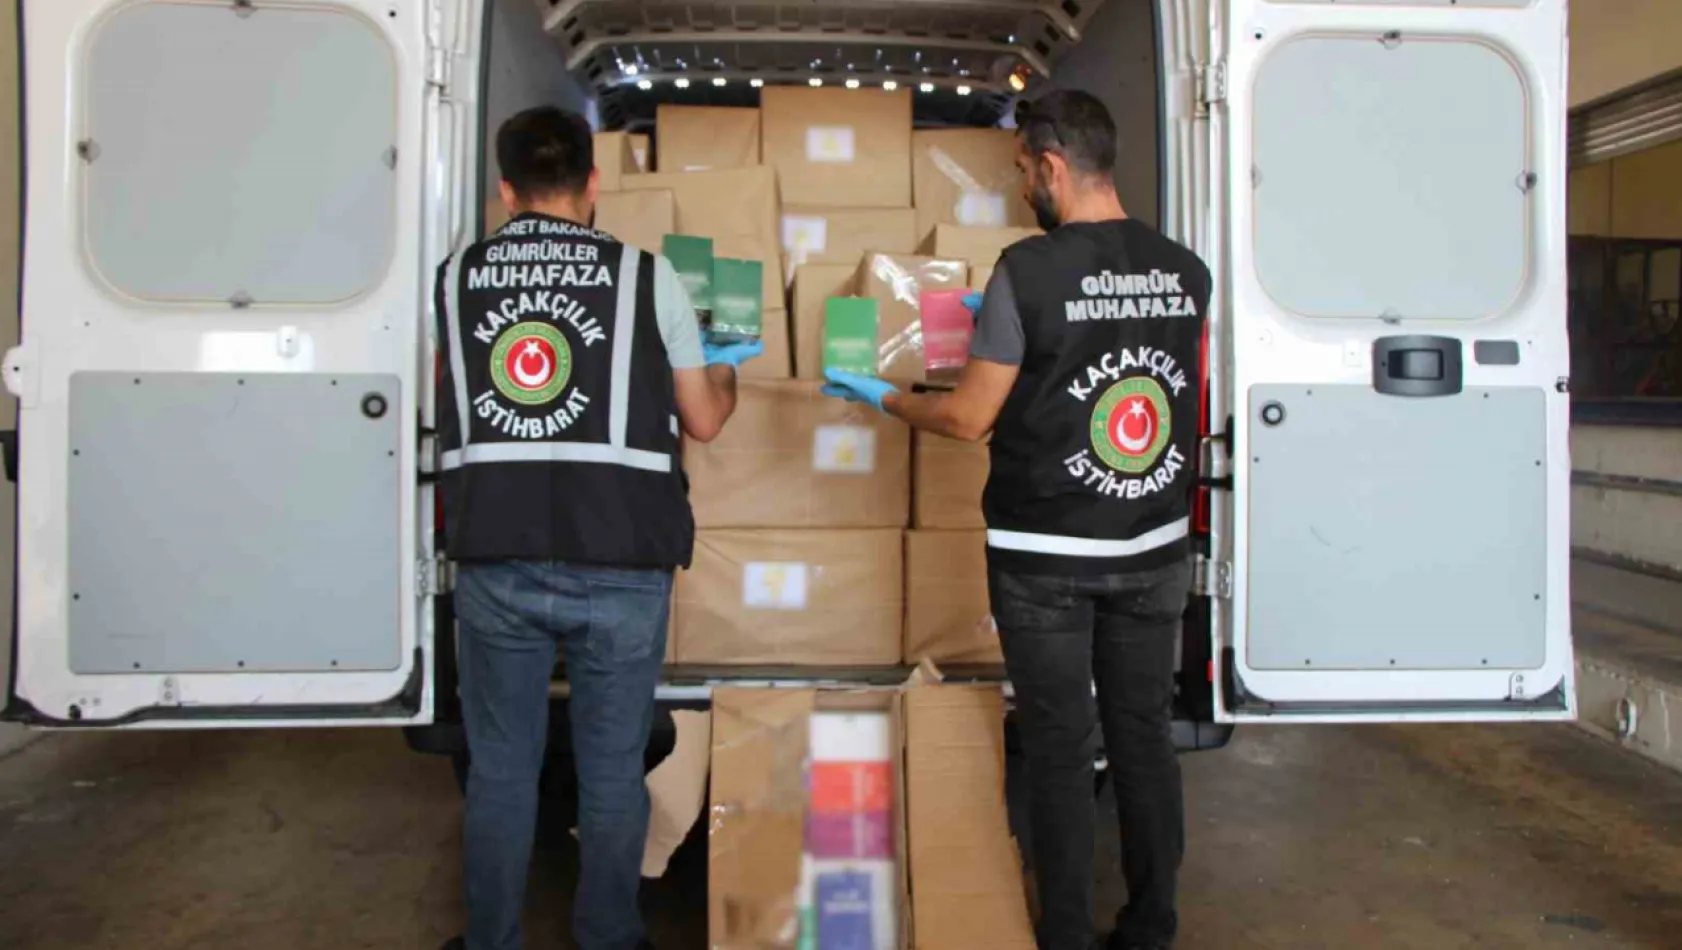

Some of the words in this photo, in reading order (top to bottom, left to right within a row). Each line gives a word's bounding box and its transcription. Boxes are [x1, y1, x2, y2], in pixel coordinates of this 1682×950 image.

[486, 239, 599, 262] GÜMRÜKLER
[468, 265, 613, 289] MUHAFAZA
[1081, 270, 1183, 296] GÜMRÜK
[474, 291, 606, 347] KAÇAKÇILIK
[1065, 296, 1197, 321] MUHAFAZA
[1067, 346, 1187, 401] KAÇAKÇILIK
[473, 388, 590, 438] İSTİHBARAT
[1063, 444, 1185, 499] İSTİHBARAT
